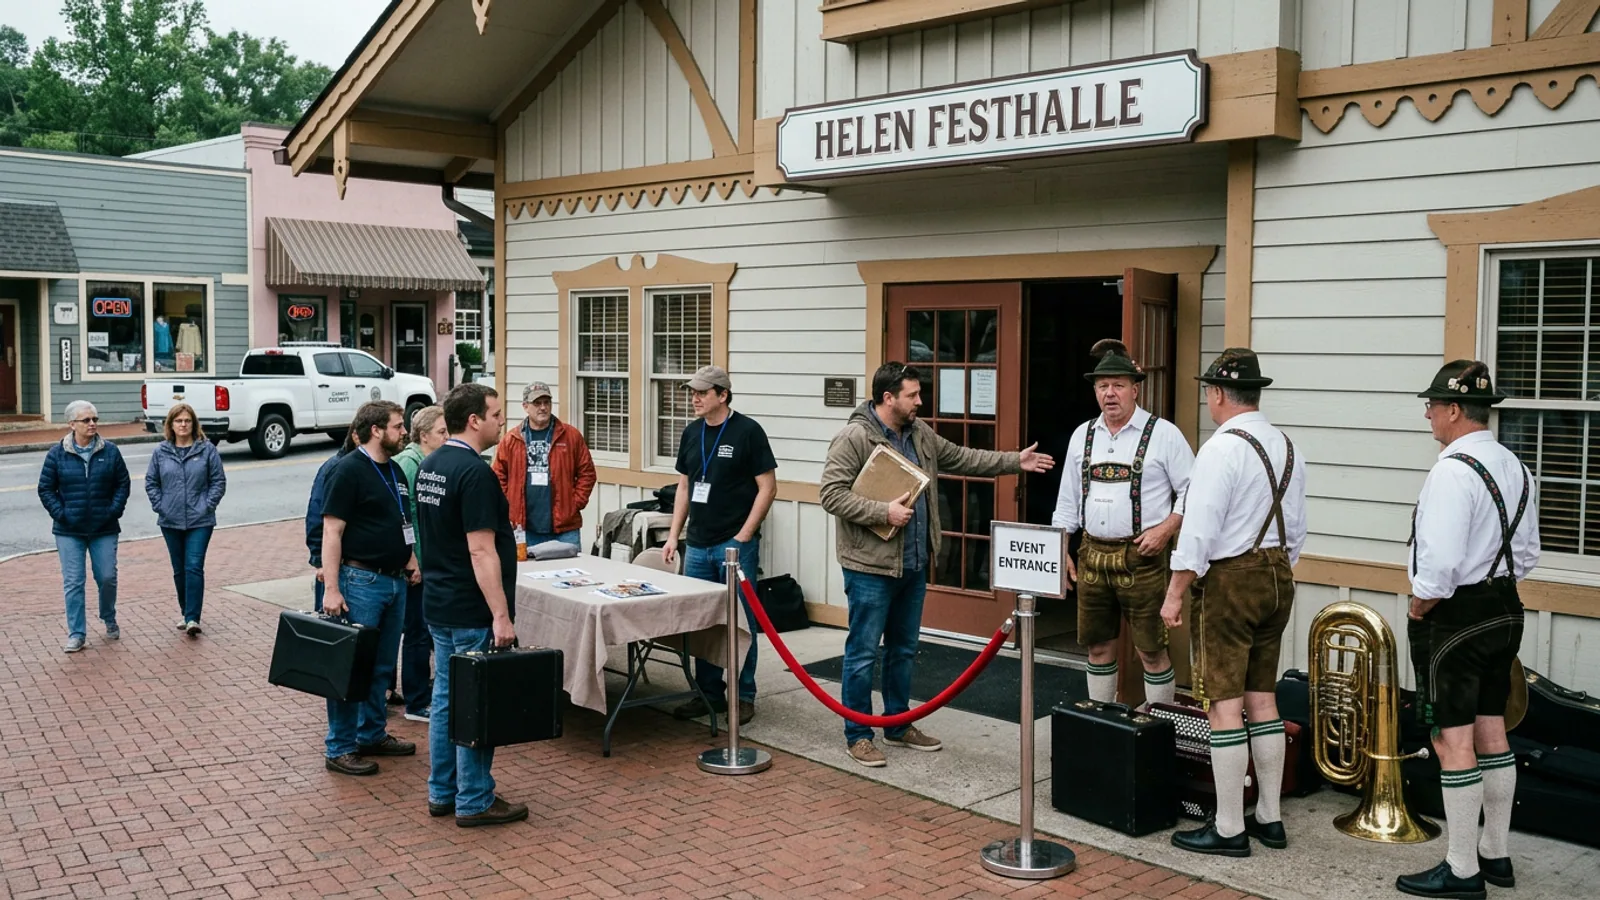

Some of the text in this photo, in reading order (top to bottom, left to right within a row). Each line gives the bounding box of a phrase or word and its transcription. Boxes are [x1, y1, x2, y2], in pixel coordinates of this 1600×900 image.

[815, 78, 1144, 161] HELEN FESTHALLE
[95, 300, 130, 315] OPEN
[1010, 540, 1046, 555] EVENT
[998, 556, 1058, 574] ENTRANCE
